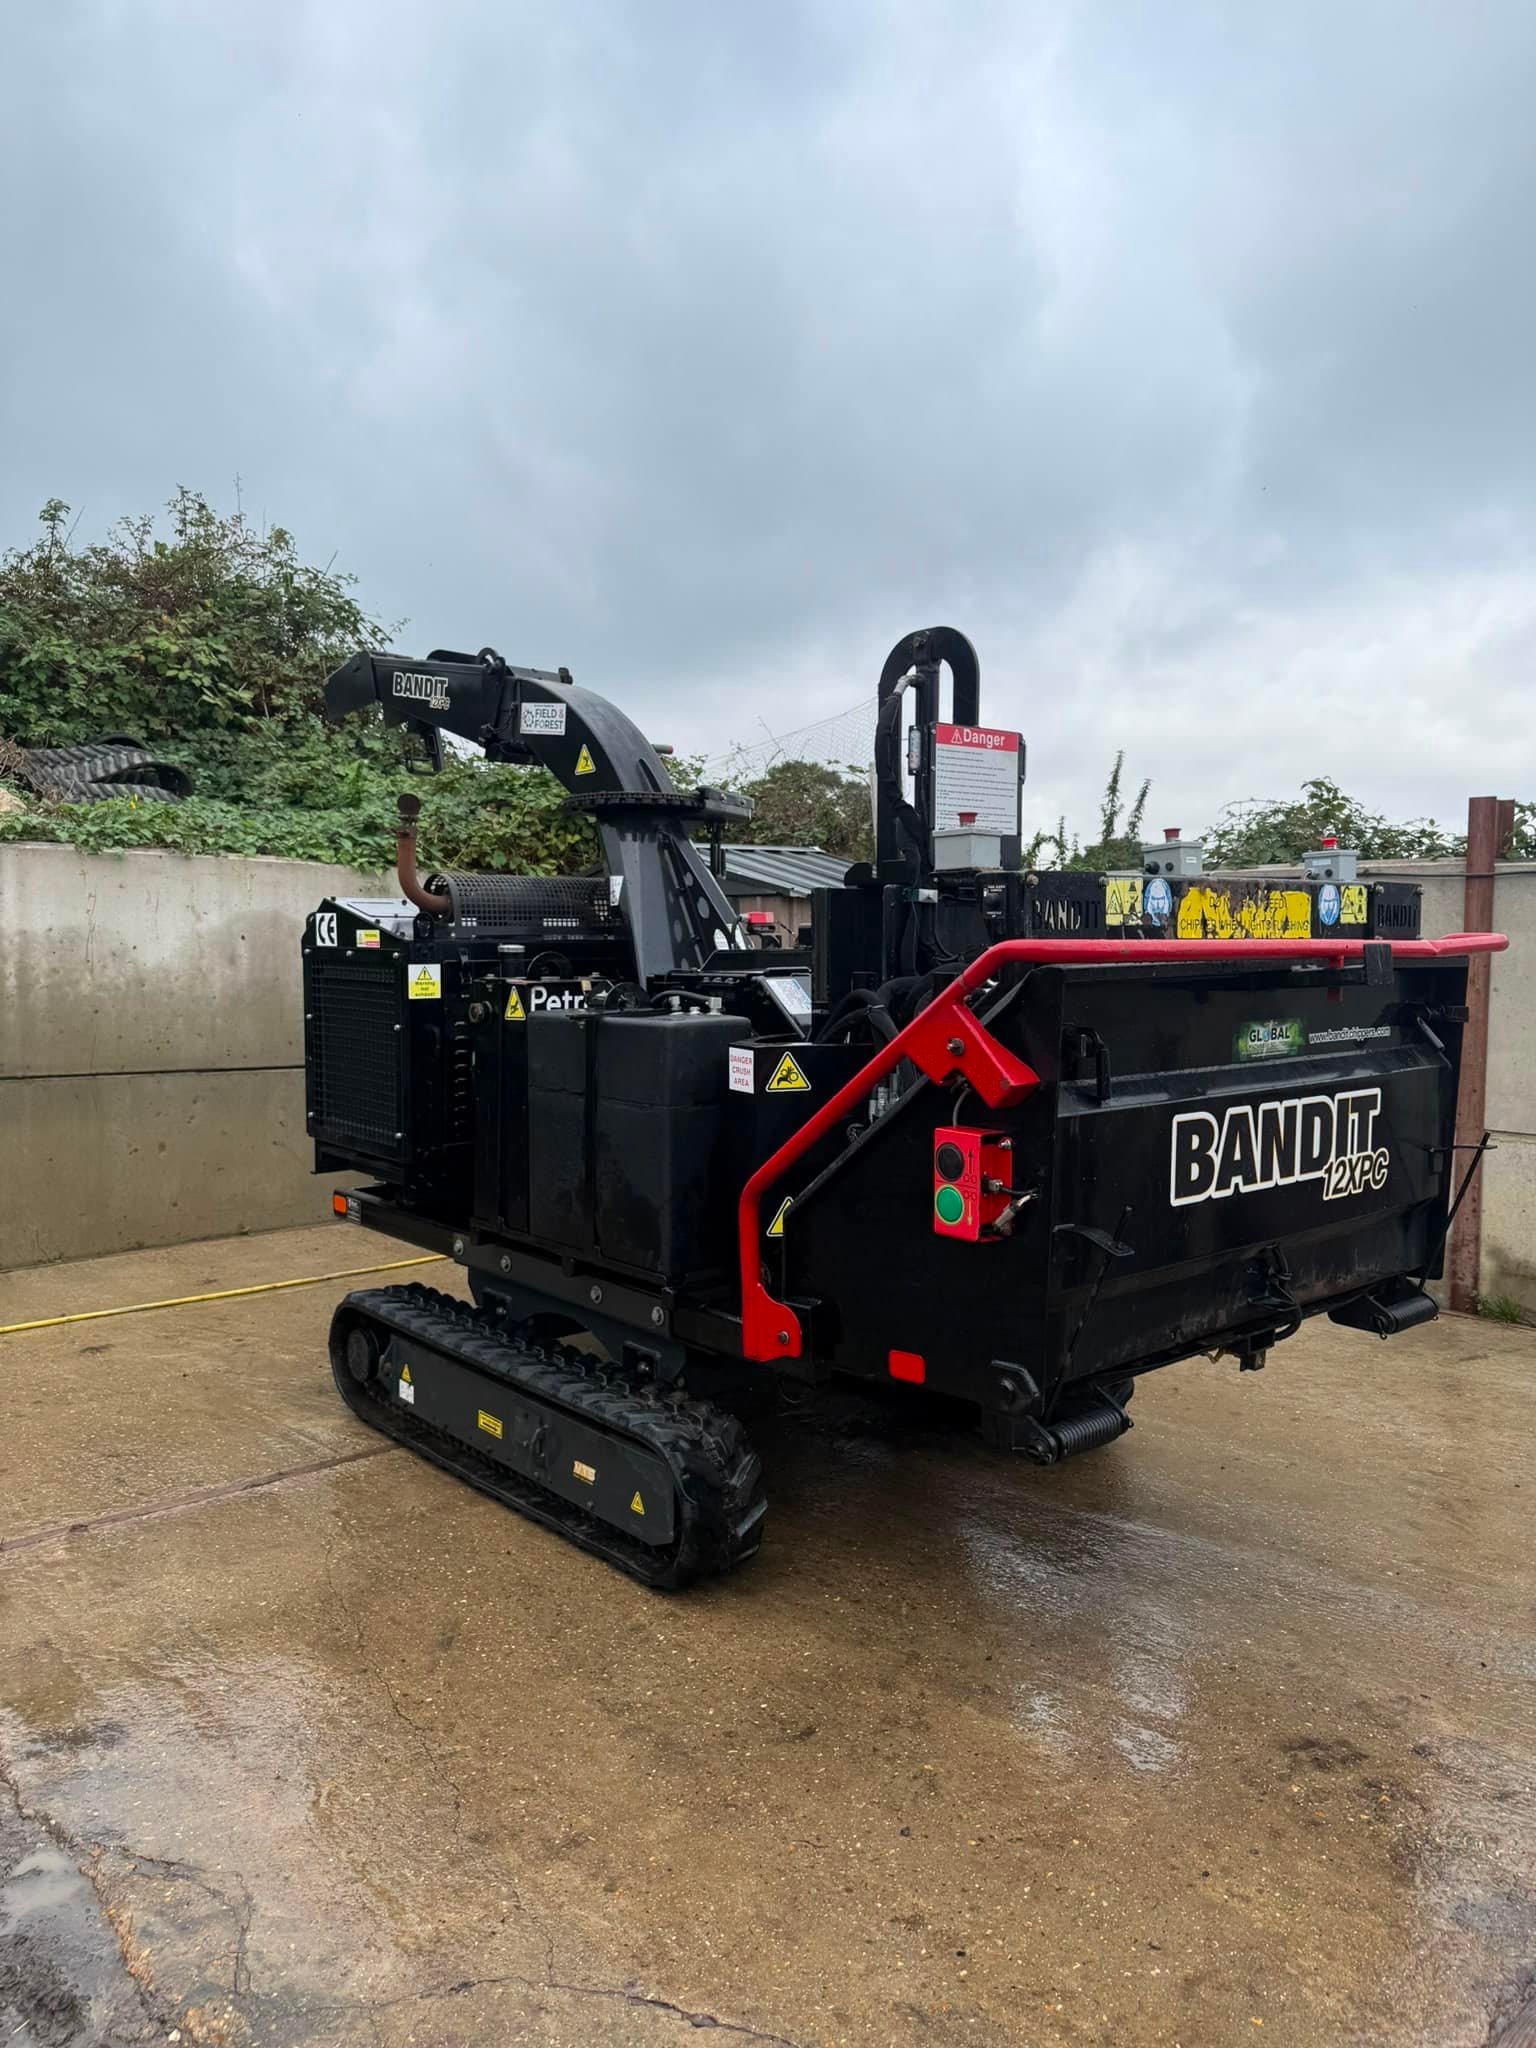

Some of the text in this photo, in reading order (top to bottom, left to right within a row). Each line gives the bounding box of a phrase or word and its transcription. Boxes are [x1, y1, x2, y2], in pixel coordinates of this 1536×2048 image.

[393, 672, 448, 701] BANDIT
[535, 708, 564, 719] FIELD &
[534, 719, 563, 730] FOREST
[963, 728, 1006, 748] Danger
[1032, 899, 1101, 930] BANDIT
[1377, 904, 1418, 928] BANDIT
[1272, 919, 1309, 931] FLSHING
[530, 985, 587, 1012] Petr
[730, 1055, 753, 1065] DANGER
[732, 1066, 751, 1075] CRUSH
[734, 1077, 749, 1087] AREA
[1170, 1088, 1382, 1207] BANDIT
[1322, 1148, 1390, 1201] 12XPC
